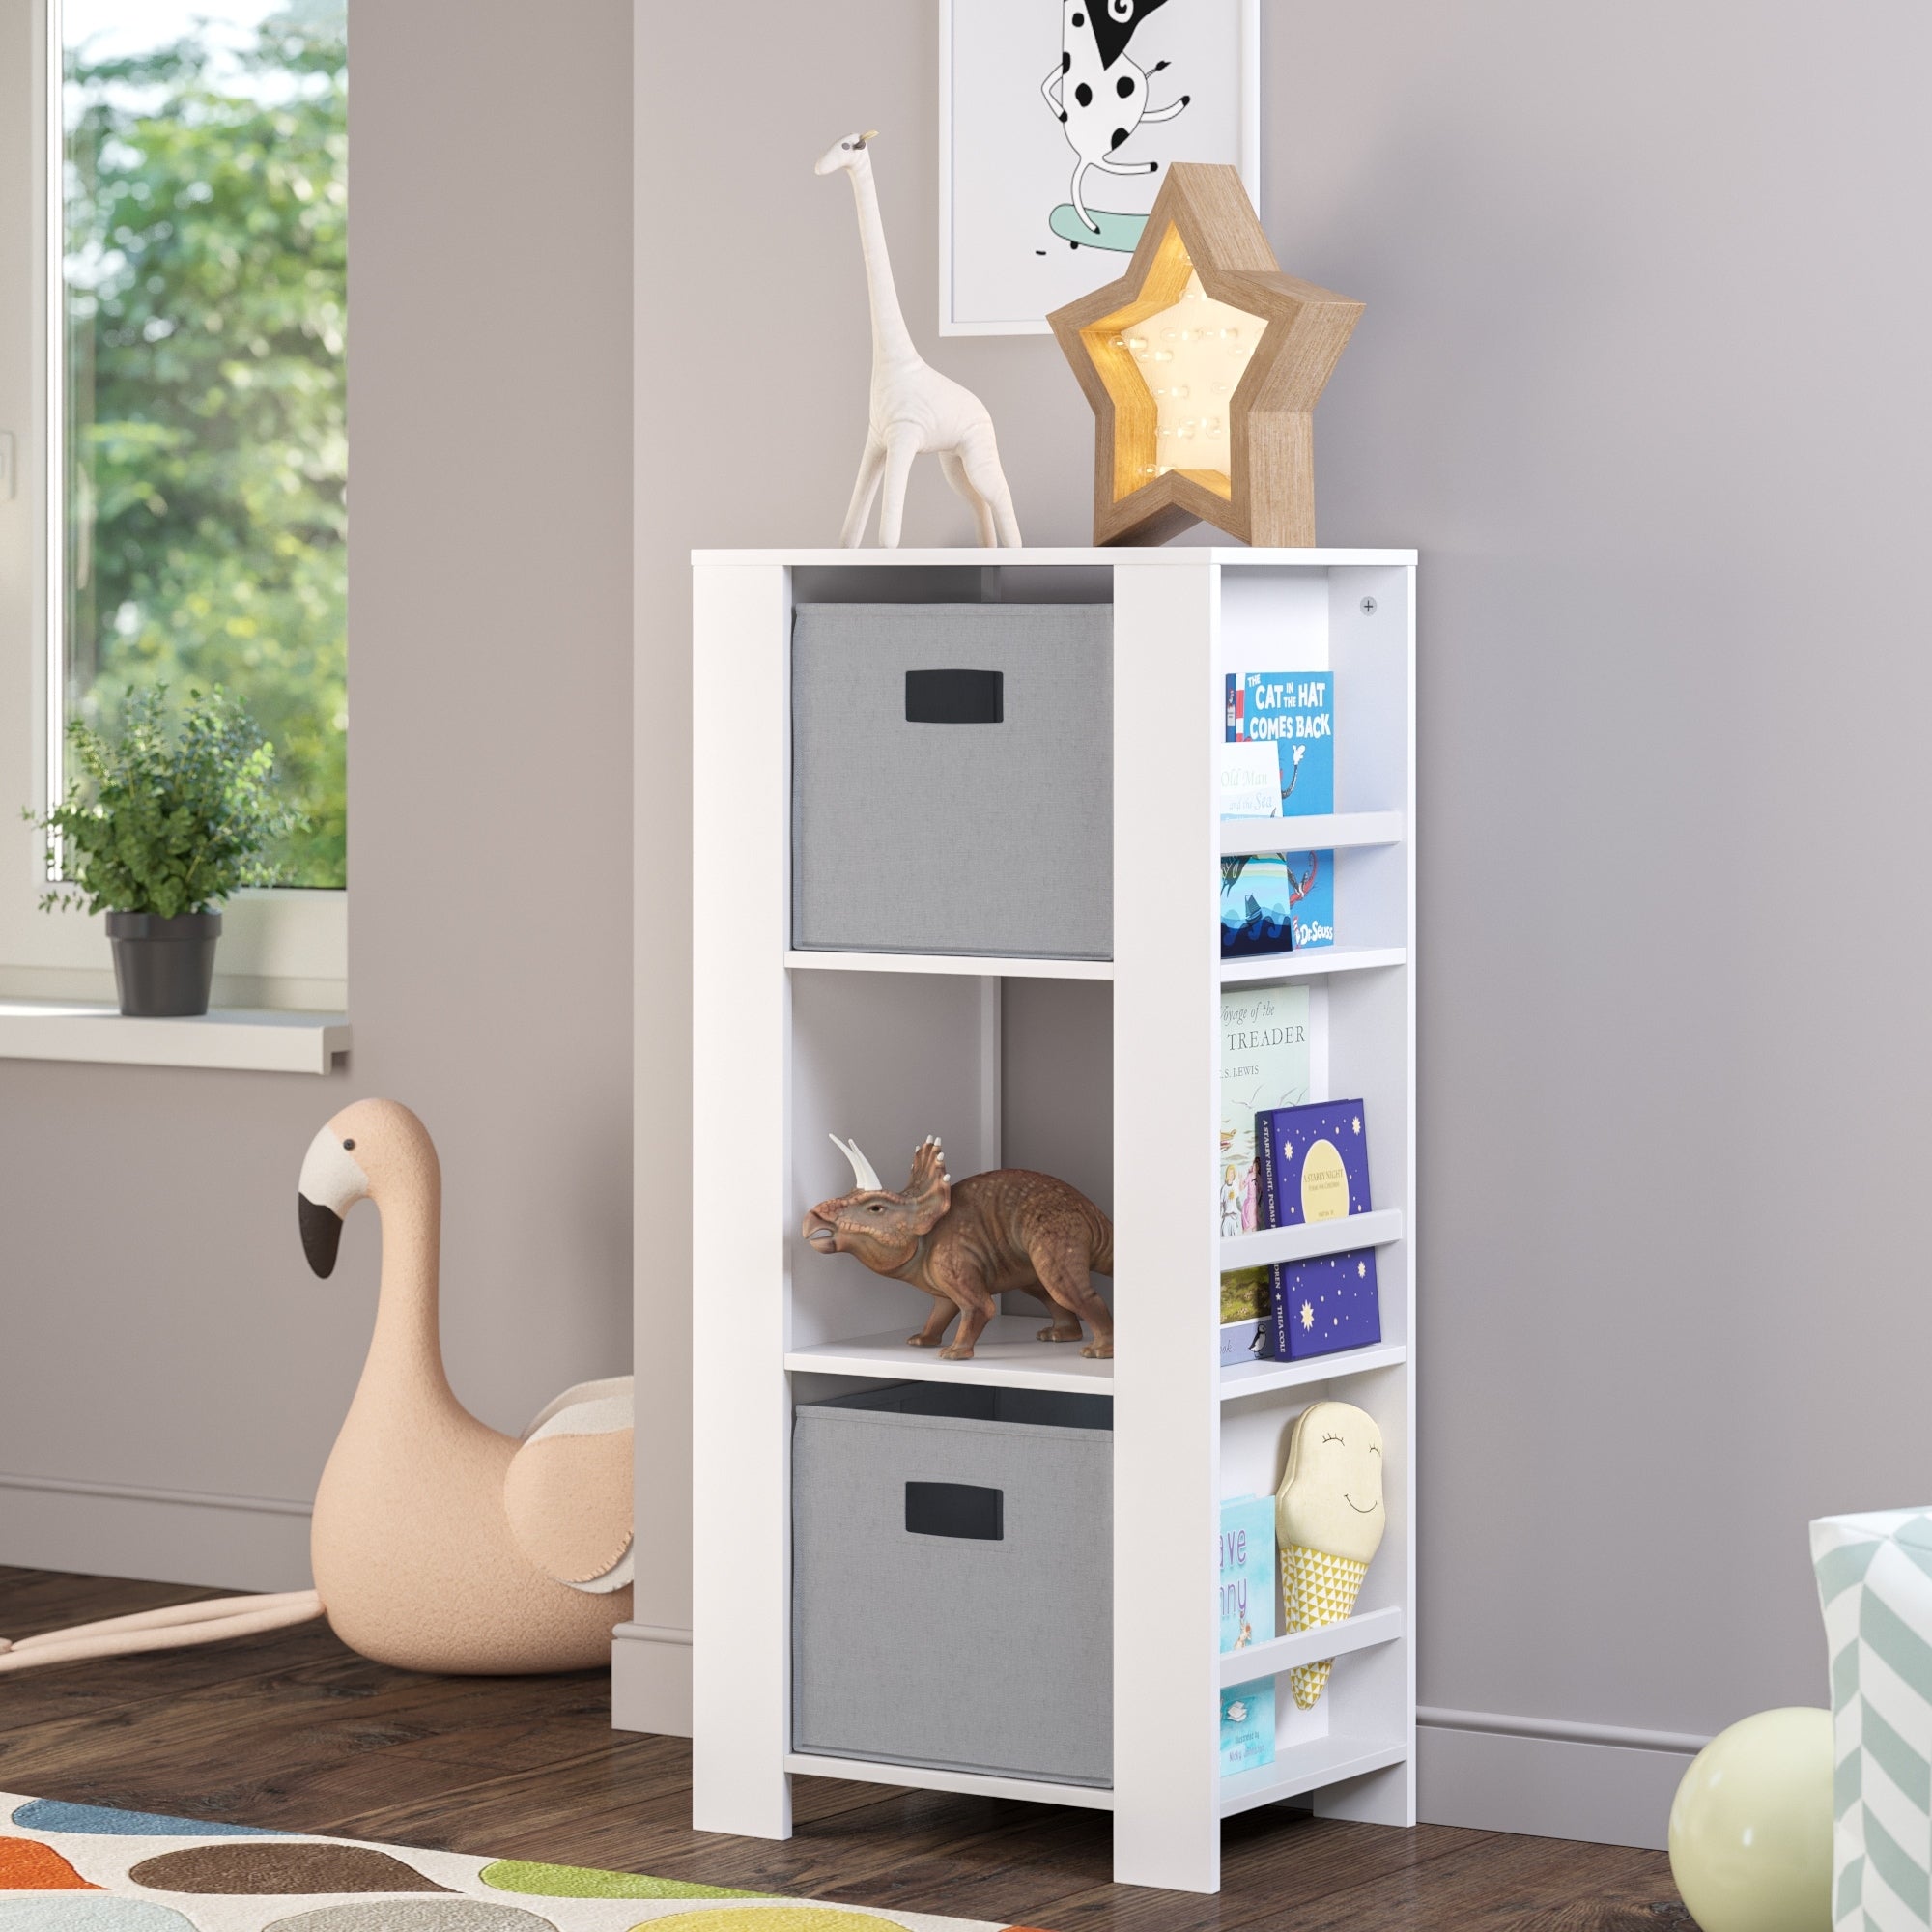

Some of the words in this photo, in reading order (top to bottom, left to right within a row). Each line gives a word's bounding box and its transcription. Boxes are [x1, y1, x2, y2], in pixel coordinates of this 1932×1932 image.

[1247, 674, 1261, 687] THE
[1286, 682, 1294, 694] IN
[1255, 684, 1283, 710] CAT
[1283, 696, 1297, 708] THE
[1298, 682, 1326, 708] HAT
[1250, 715, 1293, 740] COMES
[1296, 713, 1331, 739] BACK
[1245, 770, 1267, 786] Man
[1254, 792, 1272, 810] Sea
[1250, 1001, 1262, 1023] of
[1263, 1000, 1275, 1017] the
[1227, 1025, 1305, 1051] TREADER
[1233, 1065, 1259, 1078] LEWIS
[1263, 1127, 1271, 1159] STARRY
